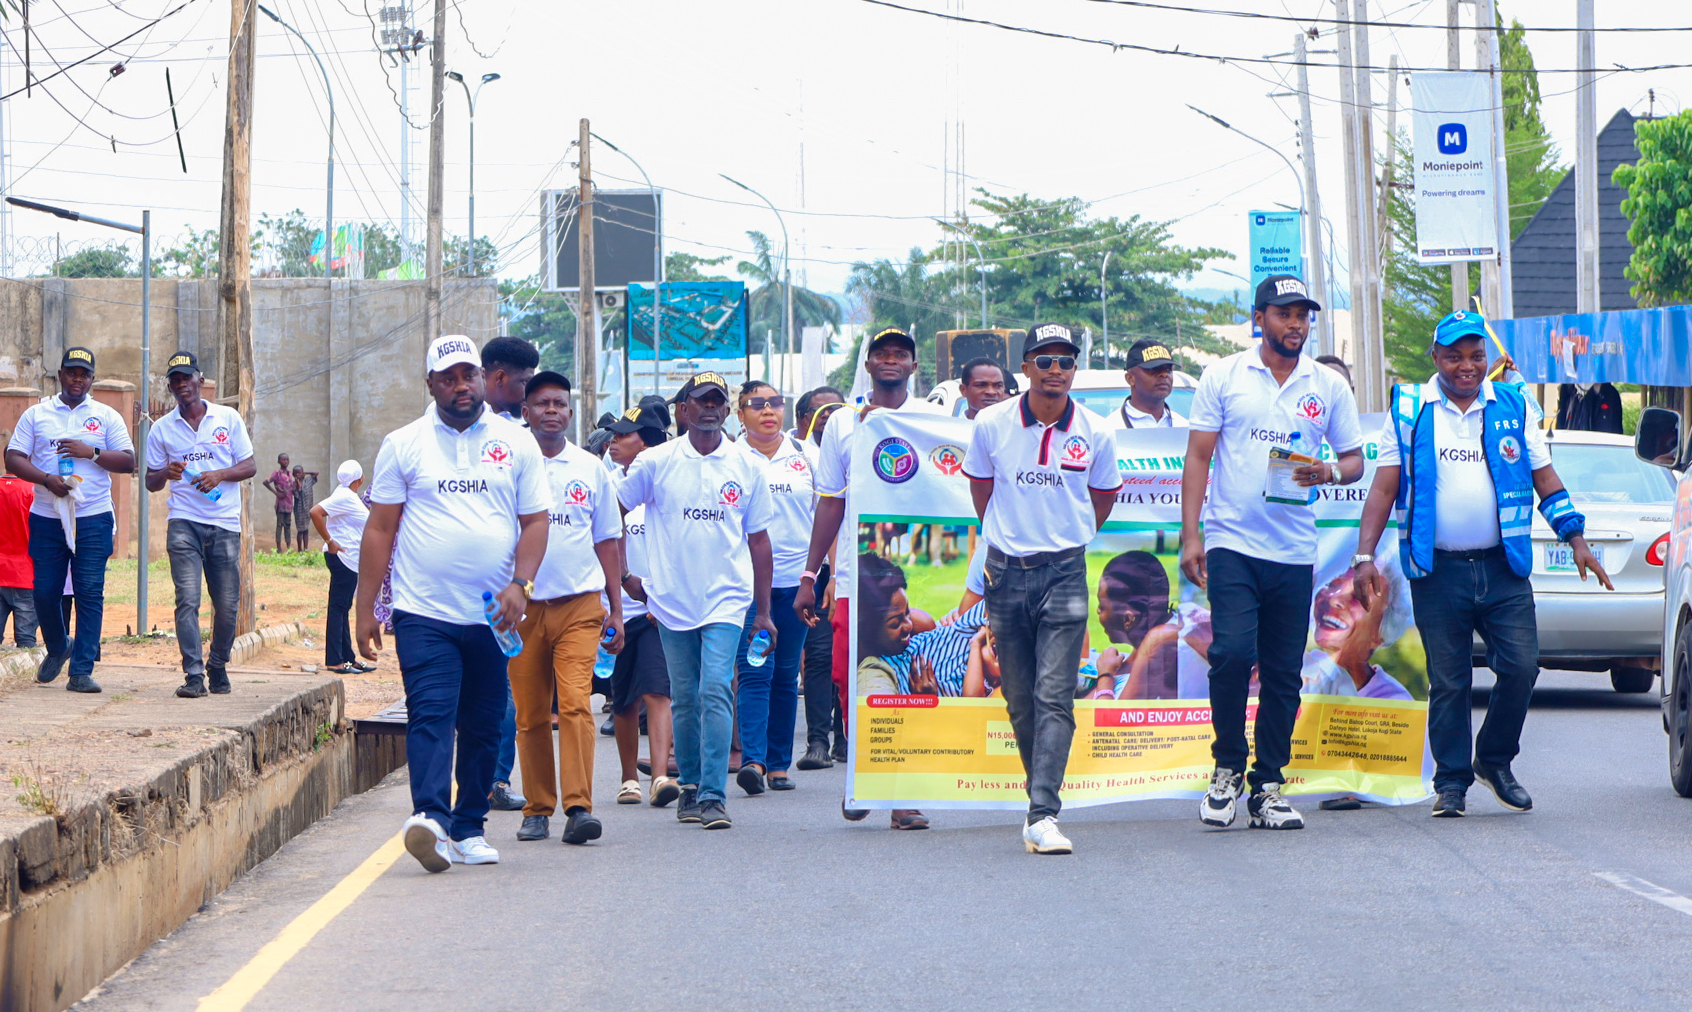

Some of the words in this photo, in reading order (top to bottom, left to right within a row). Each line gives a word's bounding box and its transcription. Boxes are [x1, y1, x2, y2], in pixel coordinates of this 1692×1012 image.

[1445, 132, 1460, 146] M
[1423, 160, 1483, 172] Moniepoint
[1422, 190, 1457, 198] Powering
[1036, 324, 1072, 343] KGSHIA
[437, 340, 472, 359] KGSHIA
[68, 350, 92, 364] KGSHIA
[694, 372, 726, 389] KGSHIA
[1250, 428, 1293, 446] KGSHIA
[182, 452, 214, 462] KGSHIA
[1118, 458, 1160, 470] ALTH
[1016, 472, 1064, 488] KGSHIA
[1124, 475, 1156, 485] nteed
[438, 480, 489, 494] KGSHIA
[769, 484, 792, 494] SHIA
[1116, 493, 1144, 504] HIA
[548, 513, 572, 526] SHIA
[683, 508, 725, 522] KGSHIA
[625, 524, 645, 535] KGS
[909, 698, 933, 706] NOW!!!
[1120, 712, 1145, 723] AND
[1147, 711, 1183, 723] ENJOY
[1185, 710, 1212, 722] ACC
[1333, 708, 1344, 716] For
[957, 779, 977, 791] Pay
[981, 780, 1001, 789] less
[1005, 780, 1027, 789] and
[1060, 779, 1102, 791] Quality
[1107, 776, 1145, 788] Health
[1149, 772, 1198, 783] Services
